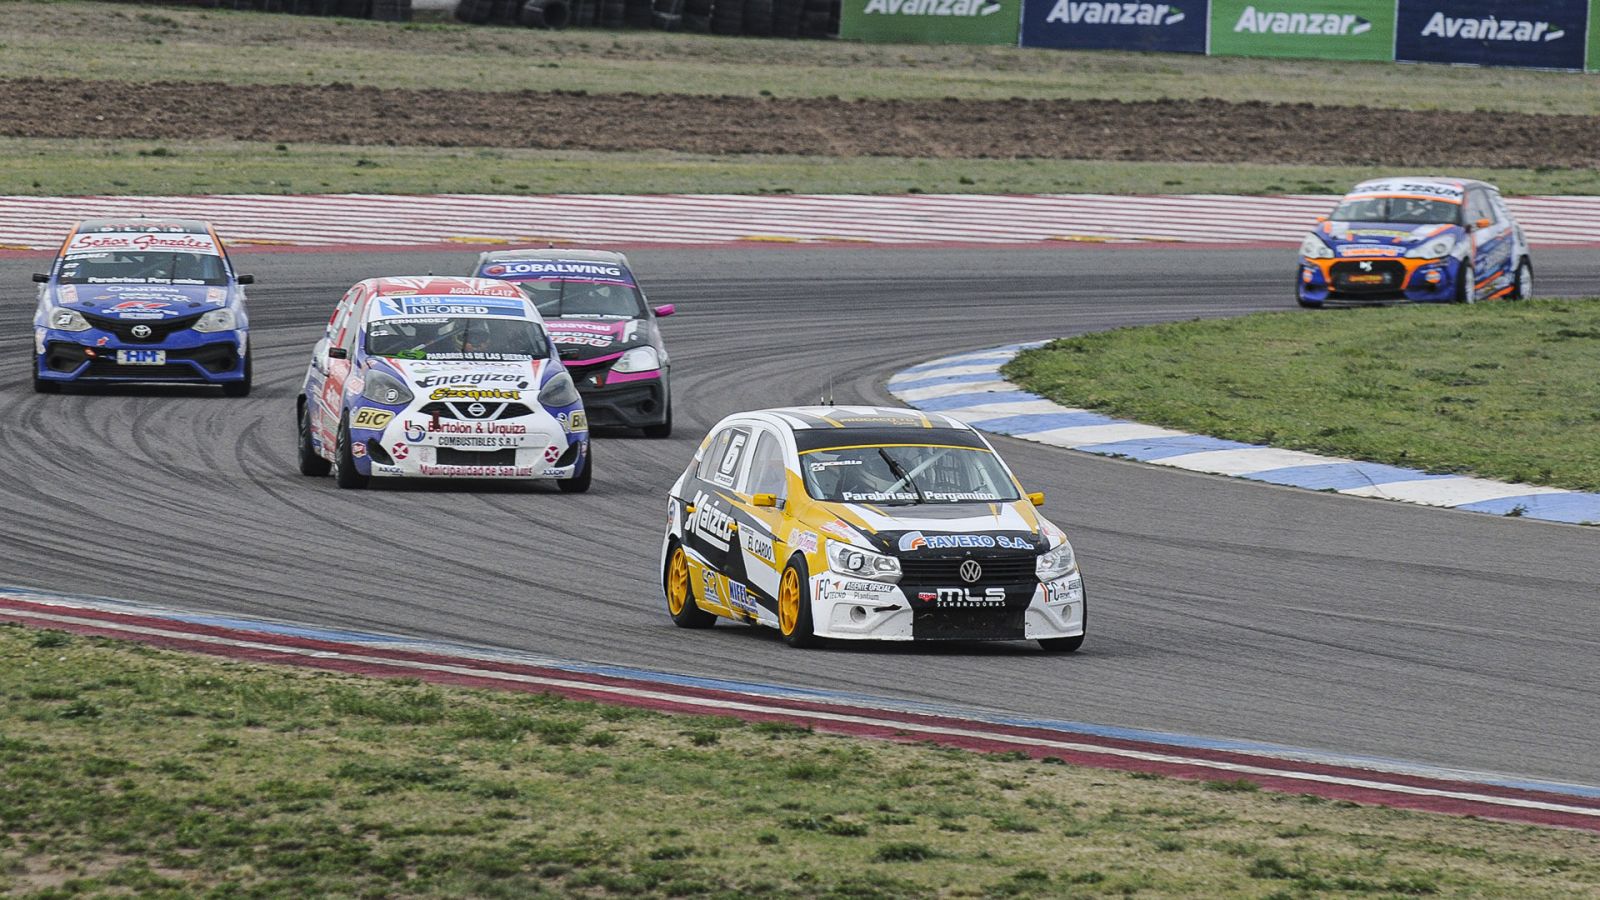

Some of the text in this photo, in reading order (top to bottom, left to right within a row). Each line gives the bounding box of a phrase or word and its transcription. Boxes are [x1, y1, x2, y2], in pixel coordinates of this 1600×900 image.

[864, 0, 984, 16] Avanzar
[1047, 0, 1170, 26] Avanzar
[1234, 5, 1355, 36] Avanzar
[1422, 11, 1548, 42] Avanzar
[70, 234, 212, 250] Señor González
[412, 305, 489, 314] NEORED
[424, 372, 525, 387] Energizer
[475, 421, 483, 433] &
[487, 421, 526, 437] Urquiza
[438, 437, 496, 447] COMBUSTIBLES
[721, 434, 745, 474] 6
[924, 491, 994, 502] Pergamino
[754, 538, 773, 560] CARDO
[924, 535, 1035, 550] FAVERO S.A.
[849, 553, 863, 570] 6
